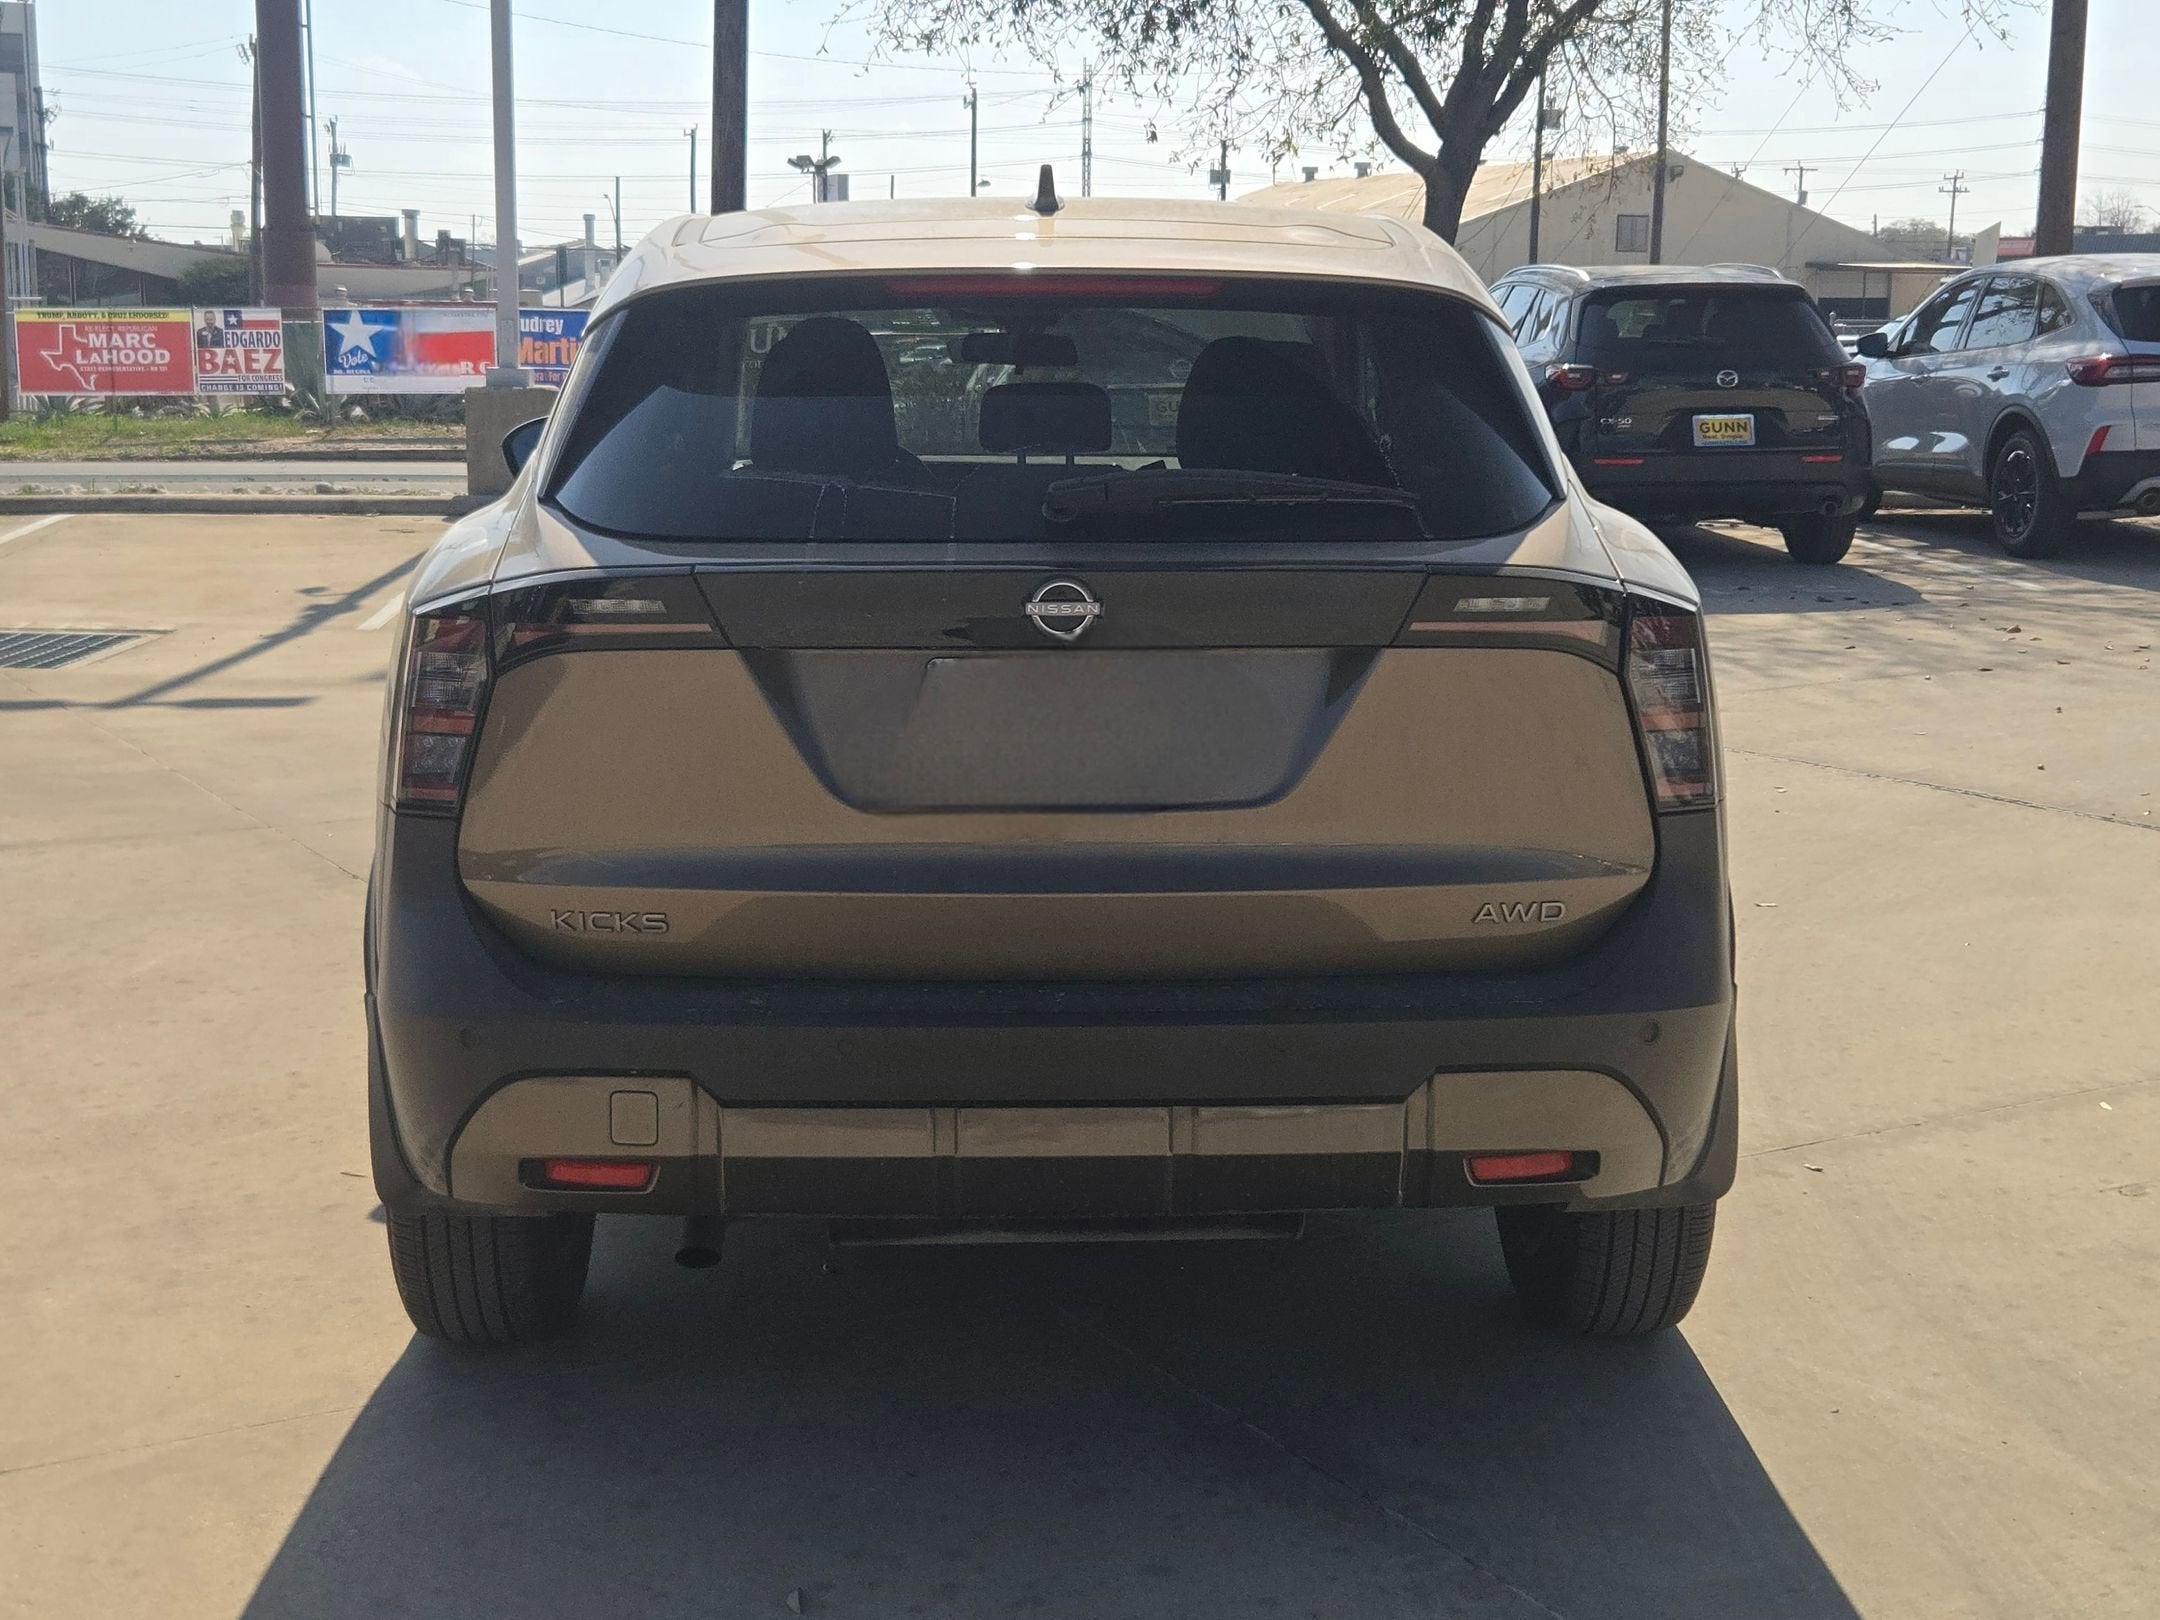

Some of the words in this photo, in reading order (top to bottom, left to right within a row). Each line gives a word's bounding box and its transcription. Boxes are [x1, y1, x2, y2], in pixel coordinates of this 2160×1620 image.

[520, 316, 564, 335] udrey
[88, 333, 156, 348] MARC
[224, 331, 281, 348] EDGARDO
[338, 350, 369, 368] Vote
[518, 336, 581, 365] Marti
[198, 348, 283, 374] BAEZ
[1700, 421, 1748, 433] GUNN
[1027, 604, 1098, 614] NISSAN
[551, 908, 669, 934] KICKS
[1472, 901, 1566, 924] AWD
